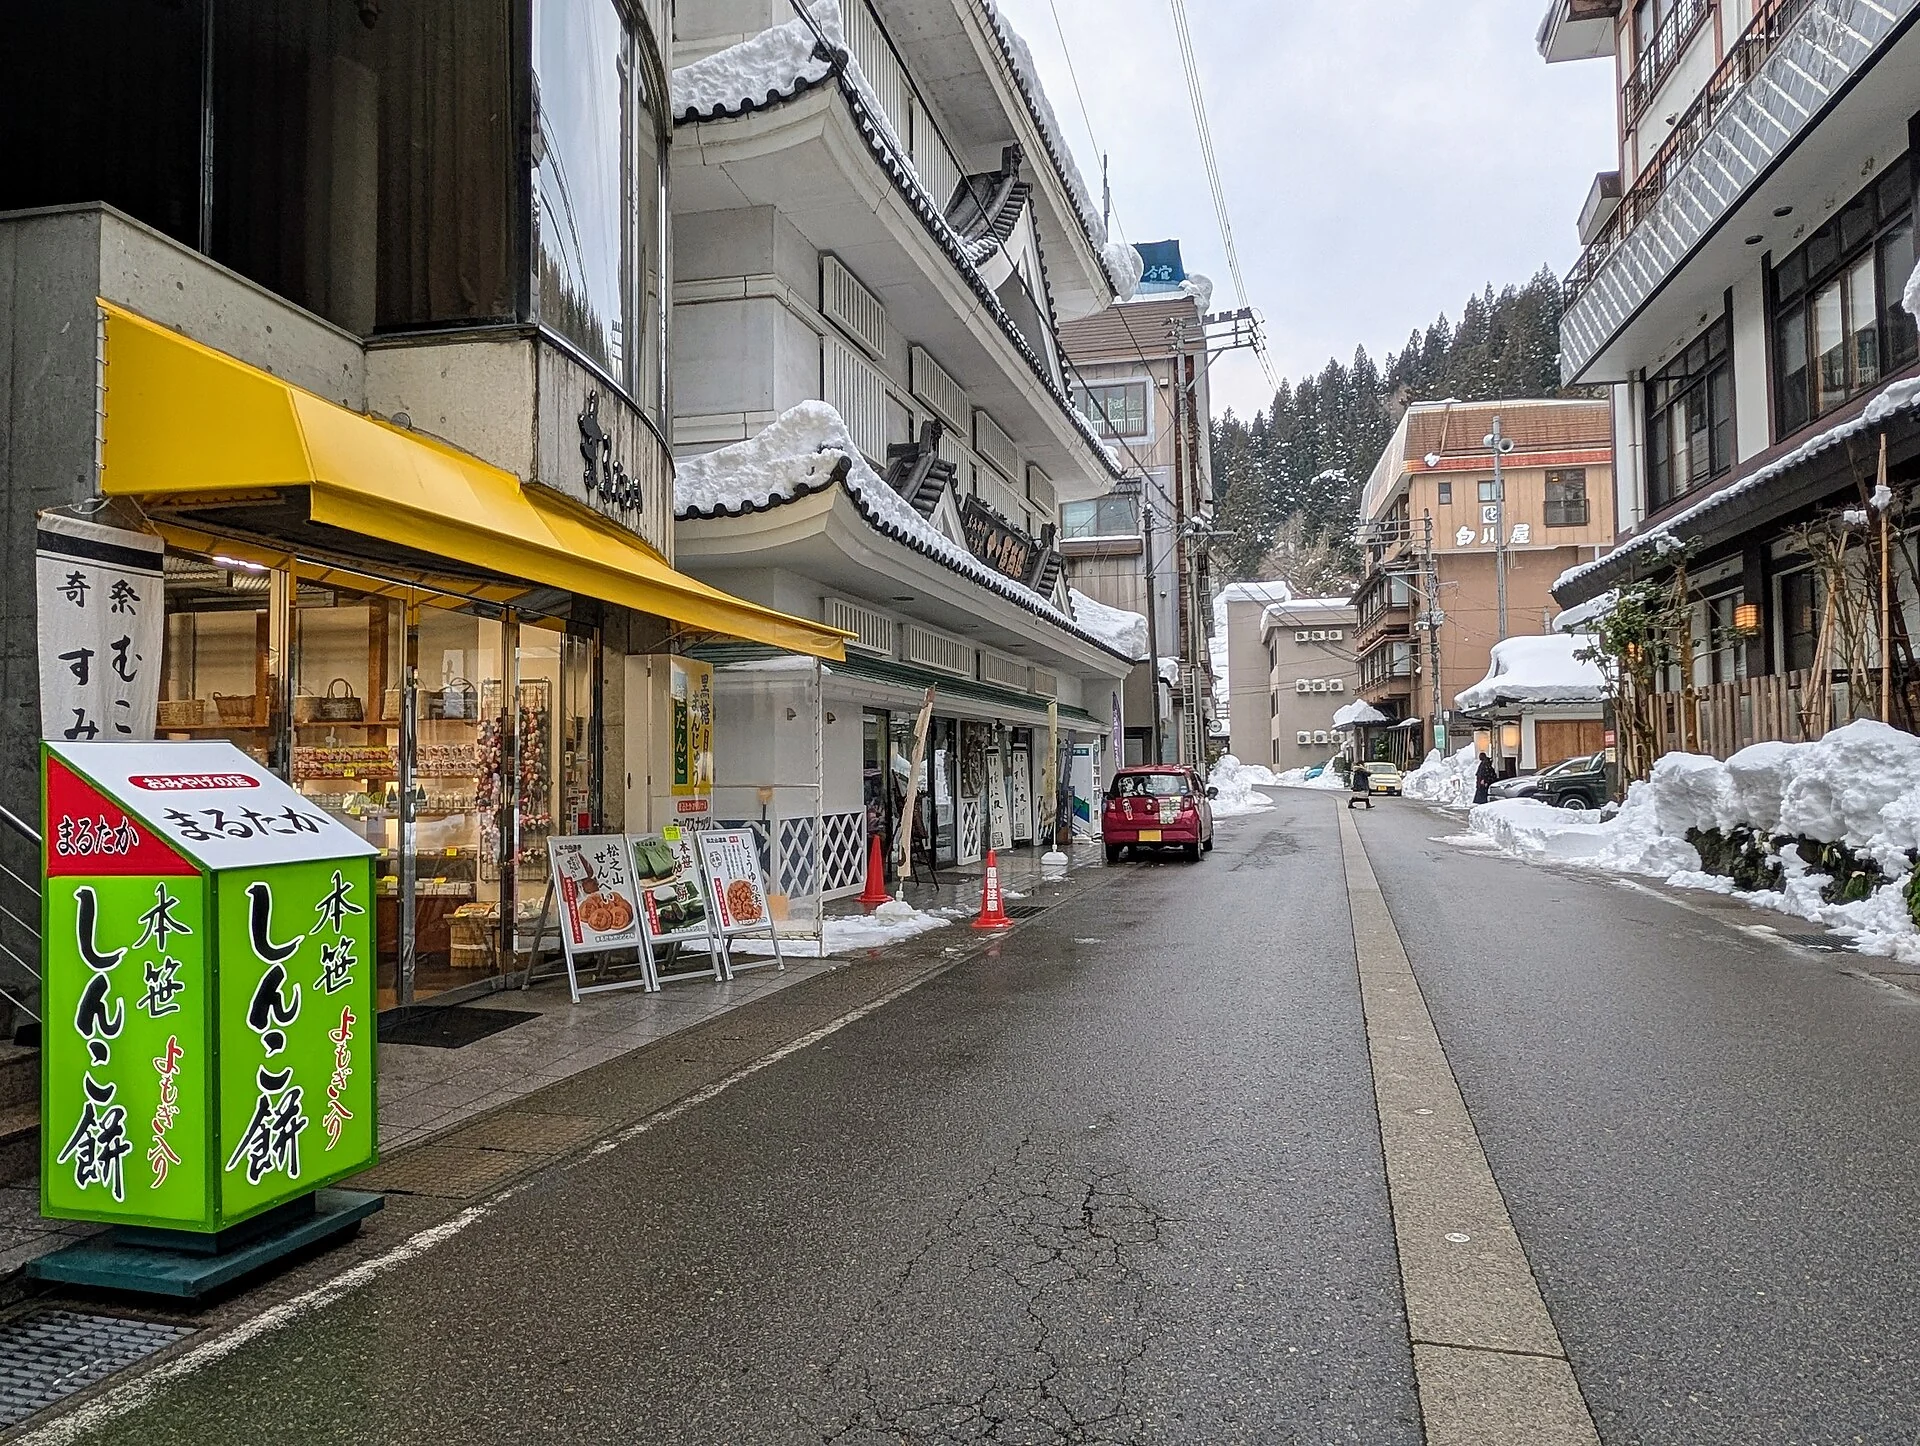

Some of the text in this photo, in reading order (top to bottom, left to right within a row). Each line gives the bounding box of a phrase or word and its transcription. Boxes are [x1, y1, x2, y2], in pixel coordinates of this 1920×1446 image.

[1455, 523, 1530, 547] 白川屋
[143, 776, 251, 790] おみやげの店
[56, 815, 139, 855] まるたか
[163, 805, 329, 841] まるたか
[594, 852, 614, 903] せんべい
[607, 844, 624, 885] 松之山
[671, 848, 688, 901] しんこ餅
[680, 840, 693, 869] 本笹
[137, 881, 193, 1017] 本笹
[310, 870, 365, 996] 本笹
[57, 886, 132, 1203] しんこ餅
[228, 882, 308, 1184] しんこ餅
[322, 1006, 355, 1152] よもぎ入り
[146, 1035, 184, 1190] よもぎ入り
